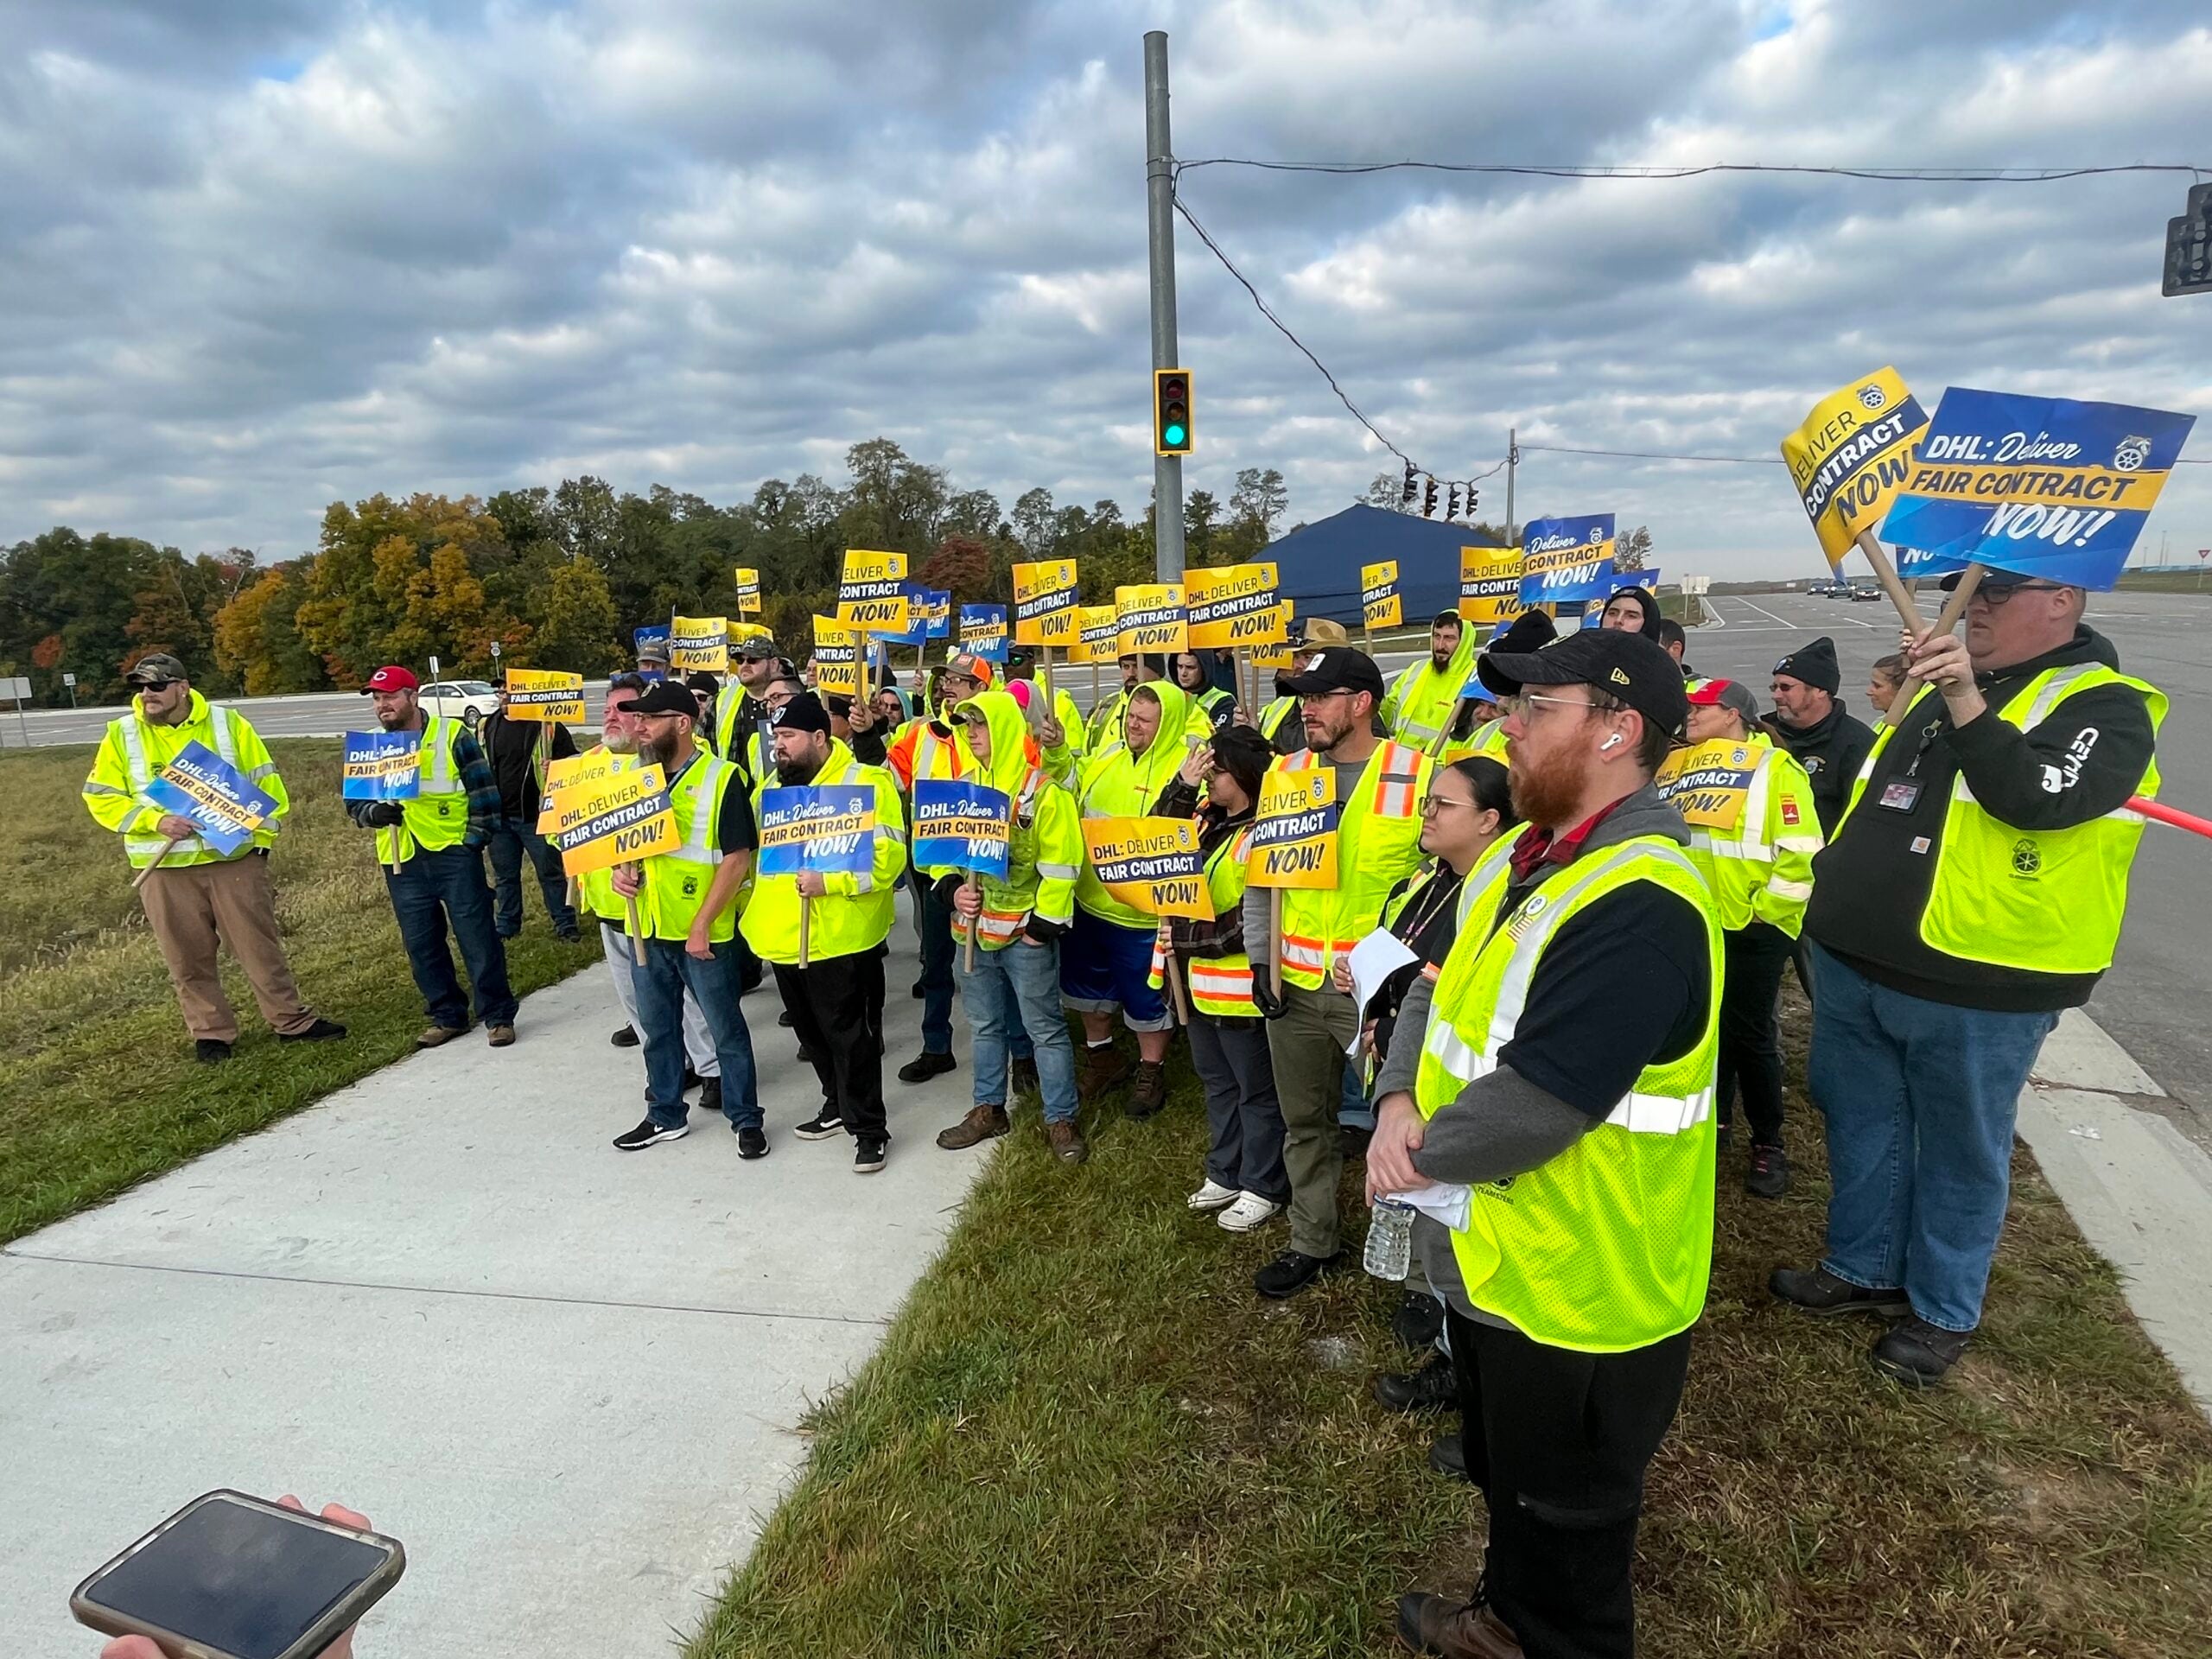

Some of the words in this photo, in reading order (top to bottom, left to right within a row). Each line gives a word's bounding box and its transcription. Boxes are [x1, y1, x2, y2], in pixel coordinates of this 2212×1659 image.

[1925, 435, 1990, 460] DHL:
[1993, 431, 2082, 462] Deliver
[1806, 413, 1905, 517] CONTRACT
[1910, 469, 1974, 493] FAIR
[1974, 472, 2137, 501] CONTRACT
[1982, 502, 2116, 547] NOW!
[1530, 535, 1577, 555] Deliver
[1529, 546, 1603, 571] CONTRACT
[844, 566, 883, 580] ELIVER
[1481, 562, 1521, 577] DELIVE
[1542, 563, 1601, 588] NOW!
[840, 582, 900, 598] CONTRACT
[1188, 590, 1209, 601] DHL:
[1211, 577, 1258, 600] DELIVER
[1462, 584, 1478, 595] FAIR
[851, 603, 899, 622] NOW!
[1018, 605, 1034, 619] FAIR
[1119, 596, 1162, 613] DELIVER
[1190, 609, 1210, 622] FAIR
[1212, 593, 1274, 617] CONTRACT
[927, 616, 944, 629] OW!
[1120, 609, 1179, 629] CONTRACT
[1230, 613, 1276, 639] NOW!
[673, 637, 721, 648] CONTRACT
[967, 637, 1000, 653] NOW!
[1134, 626, 1179, 646] NOW!
[683, 651, 719, 664] NOW!
[1090, 641, 1117, 656] NOW
[532, 681, 567, 690] DELIVER
[531, 691, 578, 702] CONTRACT
[543, 704, 578, 716] NOW!
[349, 751, 379, 762] DHL:
[175, 759, 209, 781] DHL:
[206, 773, 240, 800] Deliver
[349, 766, 377, 776] FAIR
[384, 770, 415, 788] NOW!
[547, 779, 568, 792] DHL:
[165, 771, 194, 791] FAIR
[194, 786, 252, 822] CONTRACT
[561, 808, 587, 827] DHL:
[588, 785, 639, 816] DELIVER
[190, 804, 242, 836] NOW!
[764, 810, 791, 827] DHL:
[791, 800, 836, 822] Deliver
[919, 803, 955, 819] DHL:
[563, 828, 591, 848] FAIR
[592, 797, 661, 835] CONTRACT
[763, 829, 787, 845] FAIR
[791, 817, 863, 837] CONTRACT
[919, 822, 951, 836] FAIR
[1255, 811, 1325, 842] CONTRACT
[615, 819, 664, 854] NOW!
[803, 833, 861, 859] NOW!
[967, 838, 1005, 861] NOW!
[1093, 843, 1124, 860] DHL:
[1127, 835, 1175, 855] DELIVER
[1098, 865, 1128, 880] FAIR
[1130, 856, 1194, 877] CONTRACT
[1265, 843, 1325, 874] NOW!
[1152, 882, 1198, 906] NOW!
